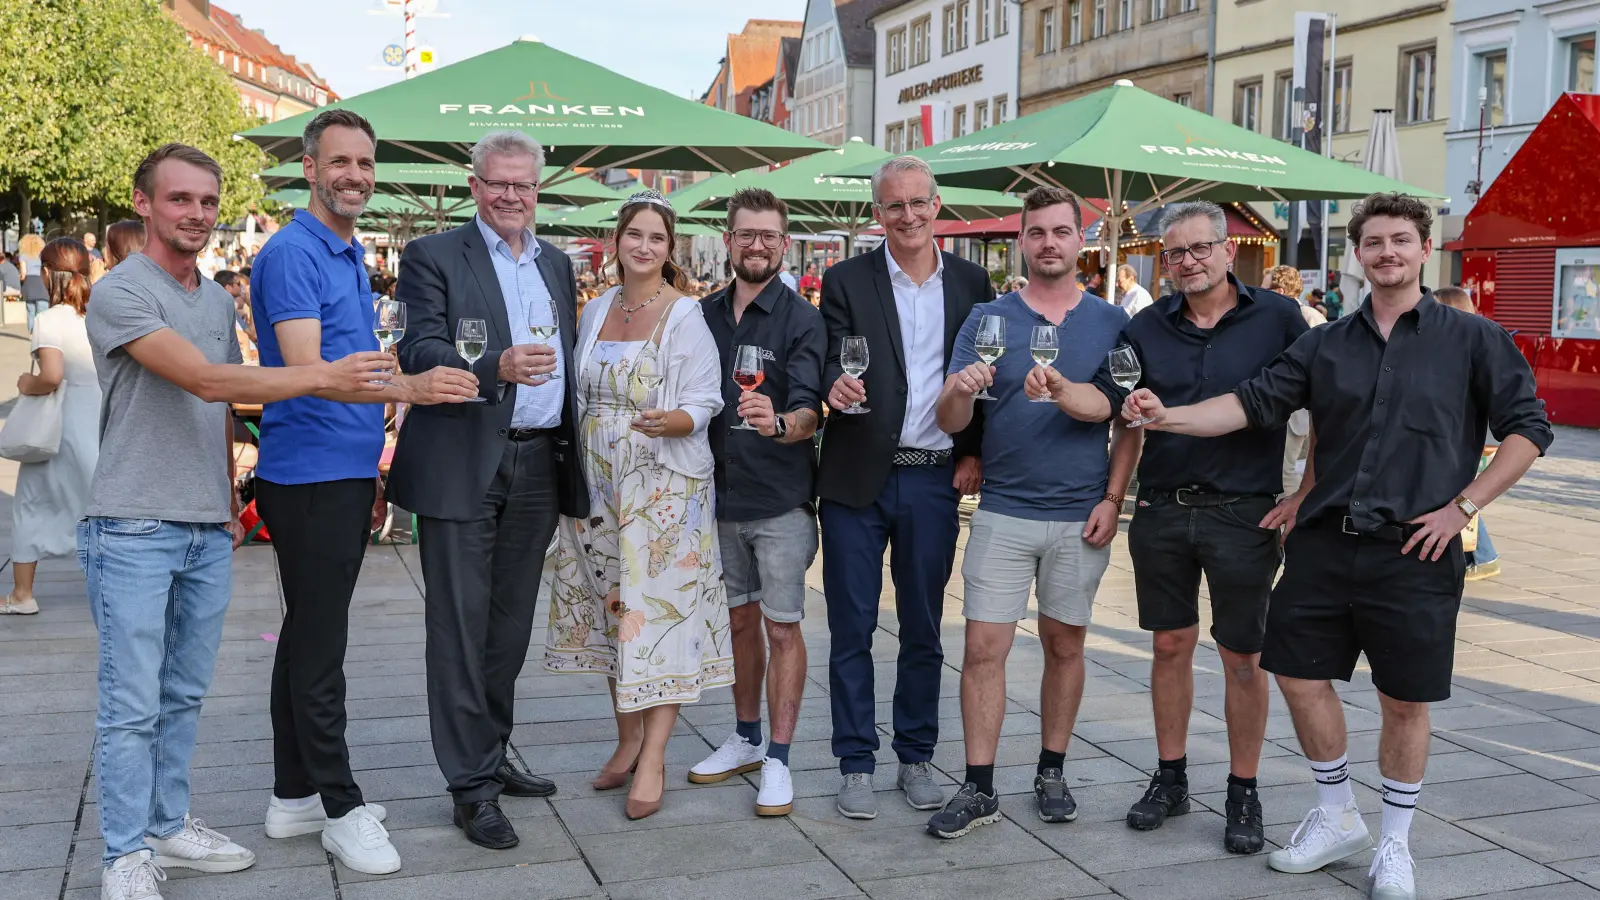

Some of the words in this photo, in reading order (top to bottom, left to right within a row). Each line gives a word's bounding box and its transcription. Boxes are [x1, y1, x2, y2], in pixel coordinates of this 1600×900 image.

[897, 64, 983, 104] ADLER-APOTHEKE
[439, 104, 645, 116] FRANKEN
[1140, 145, 1287, 165] FRANKEN
[813, 177, 872, 185] FRAN
